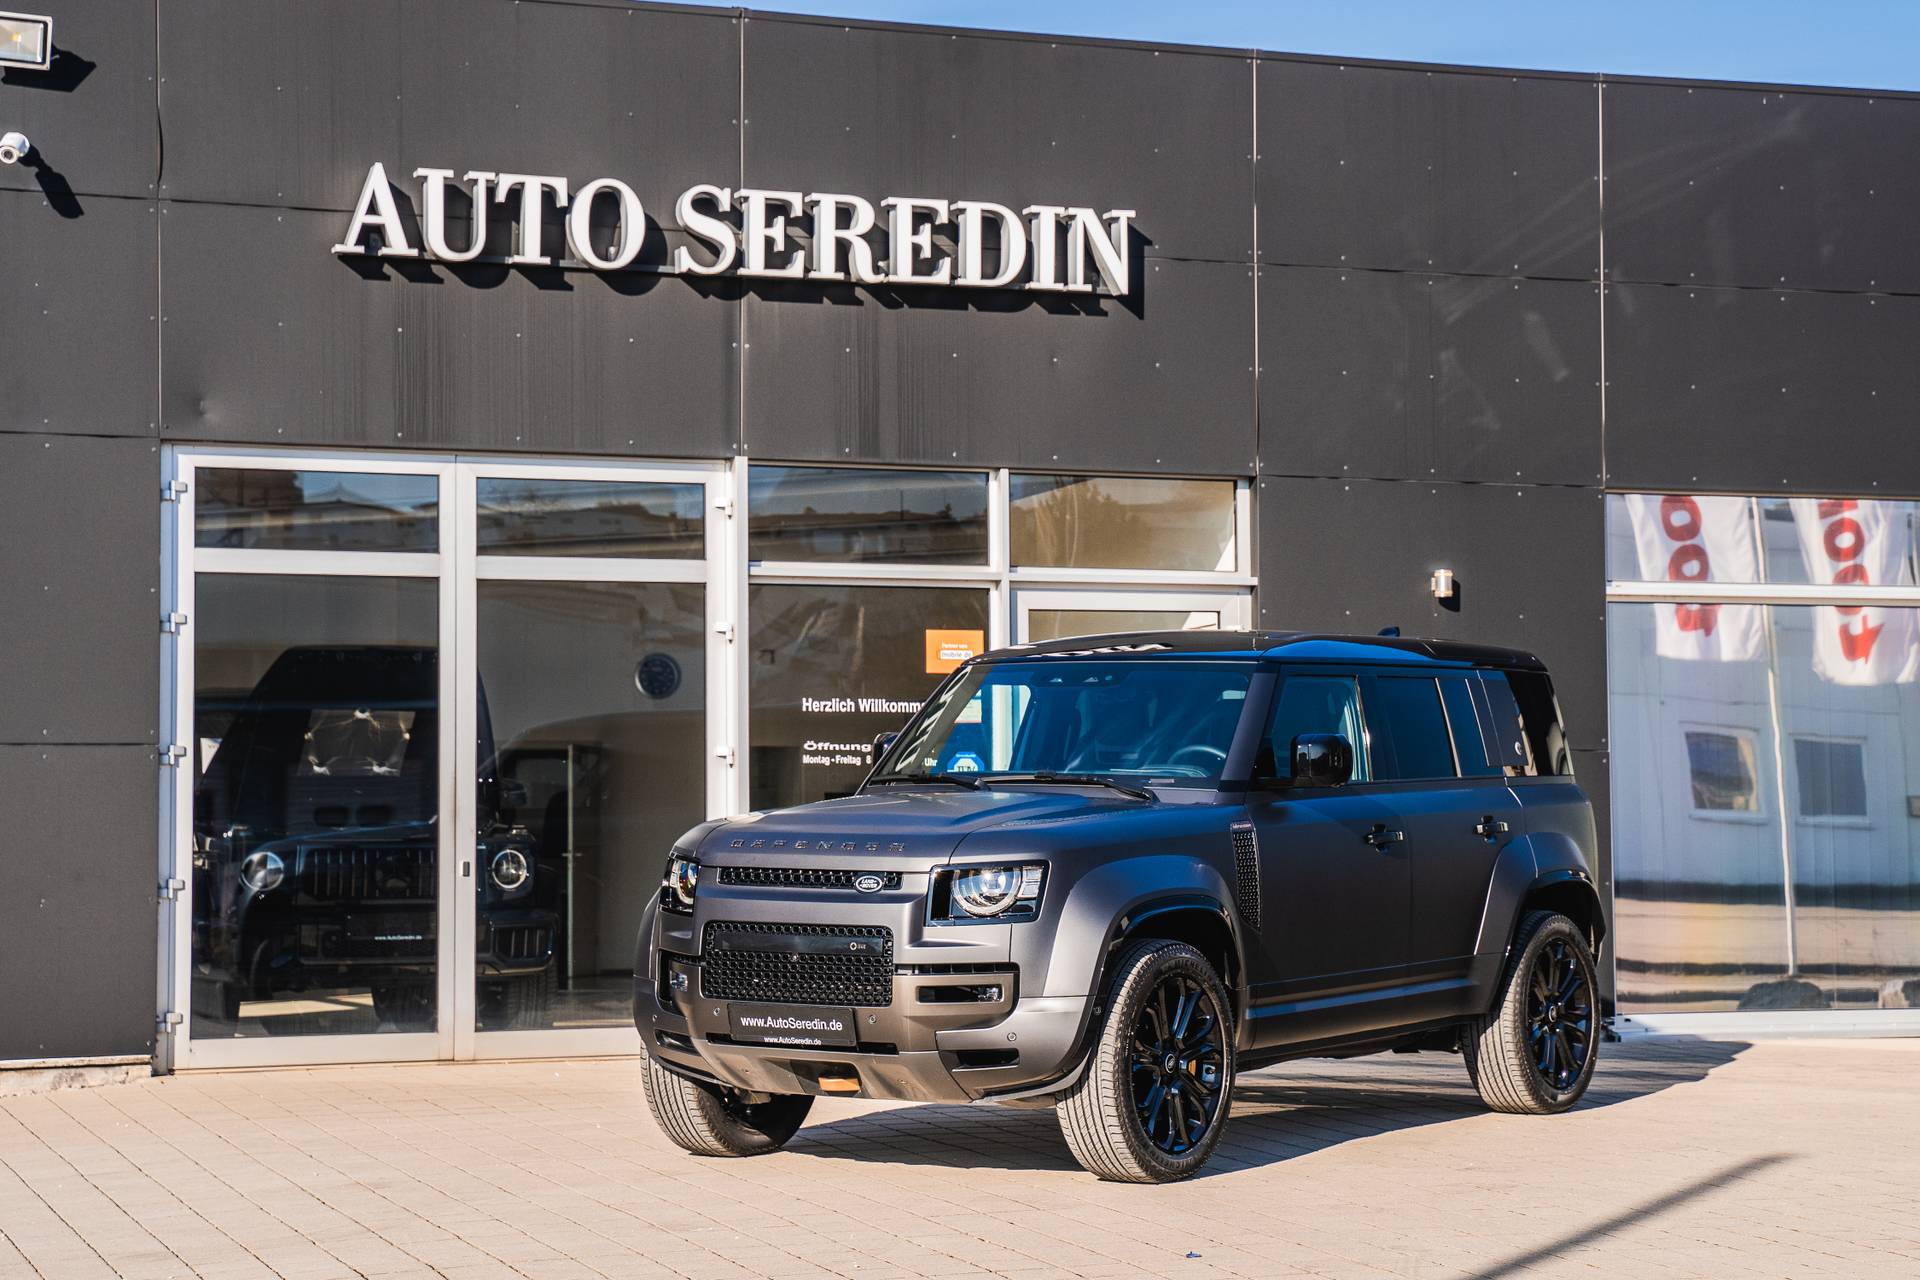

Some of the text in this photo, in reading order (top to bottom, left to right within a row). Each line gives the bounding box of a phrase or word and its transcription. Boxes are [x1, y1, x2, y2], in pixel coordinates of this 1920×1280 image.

[333, 161, 1137, 297] AUTO SEREDIN
[802, 697, 855, 712] Herzlich
[803, 740, 872, 753] Öffnung
[924, 757, 938, 767] Uhr
[730, 839, 905, 851] DEFENDER
[740, 1016, 843, 1031] www.AutoSeredin.de
[764, 1036, 822, 1046] www.AutoSeredin.de
